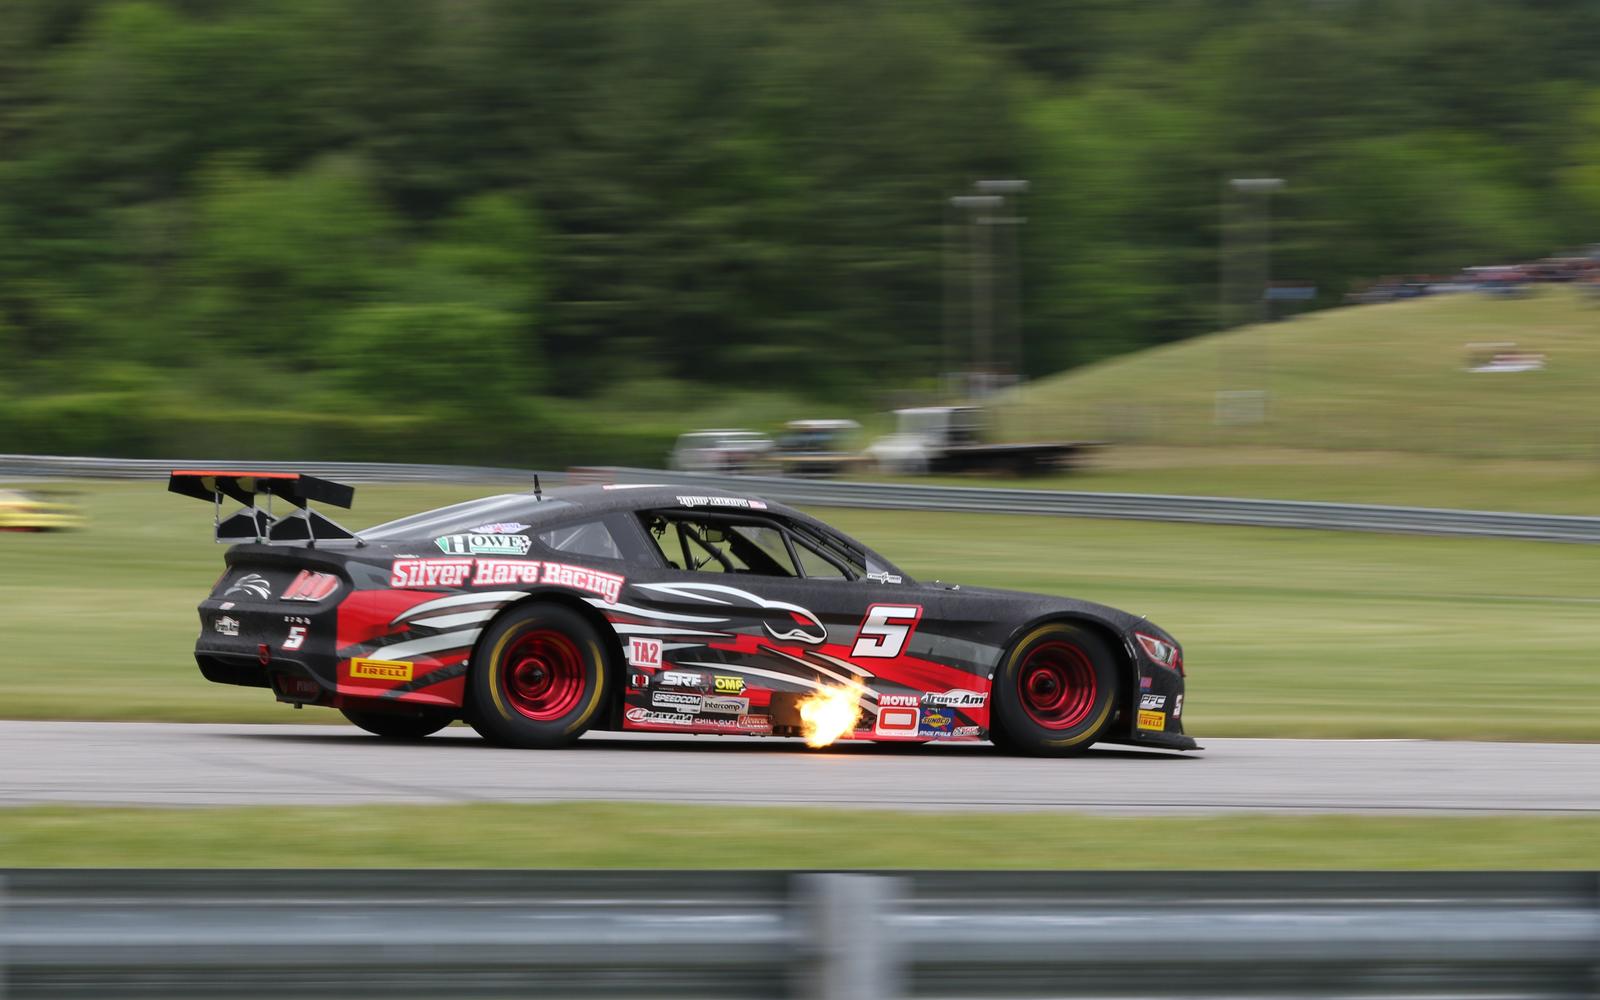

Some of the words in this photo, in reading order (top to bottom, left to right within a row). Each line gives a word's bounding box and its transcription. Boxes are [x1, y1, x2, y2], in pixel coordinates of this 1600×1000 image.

[446, 535, 520, 553] HOWE
[391, 558, 473, 588] Silver
[471, 559, 540, 586] Hare
[540, 560, 625, 604] Racing
[281, 626, 307, 650] 5
[850, 605, 920, 658] 5
[632, 641, 659, 664] TA2
[356, 661, 408, 677] PIRELLI
[715, 678, 744, 690] OMP
[654, 693, 701, 705] SPEEDCOM
[704, 700, 740, 711] Intercomp
[880, 695, 919, 706] MOTUL
[925, 693, 959, 704] Trans
[960, 694, 984, 704] Am
[694, 718, 737, 726] CHILLOUT
